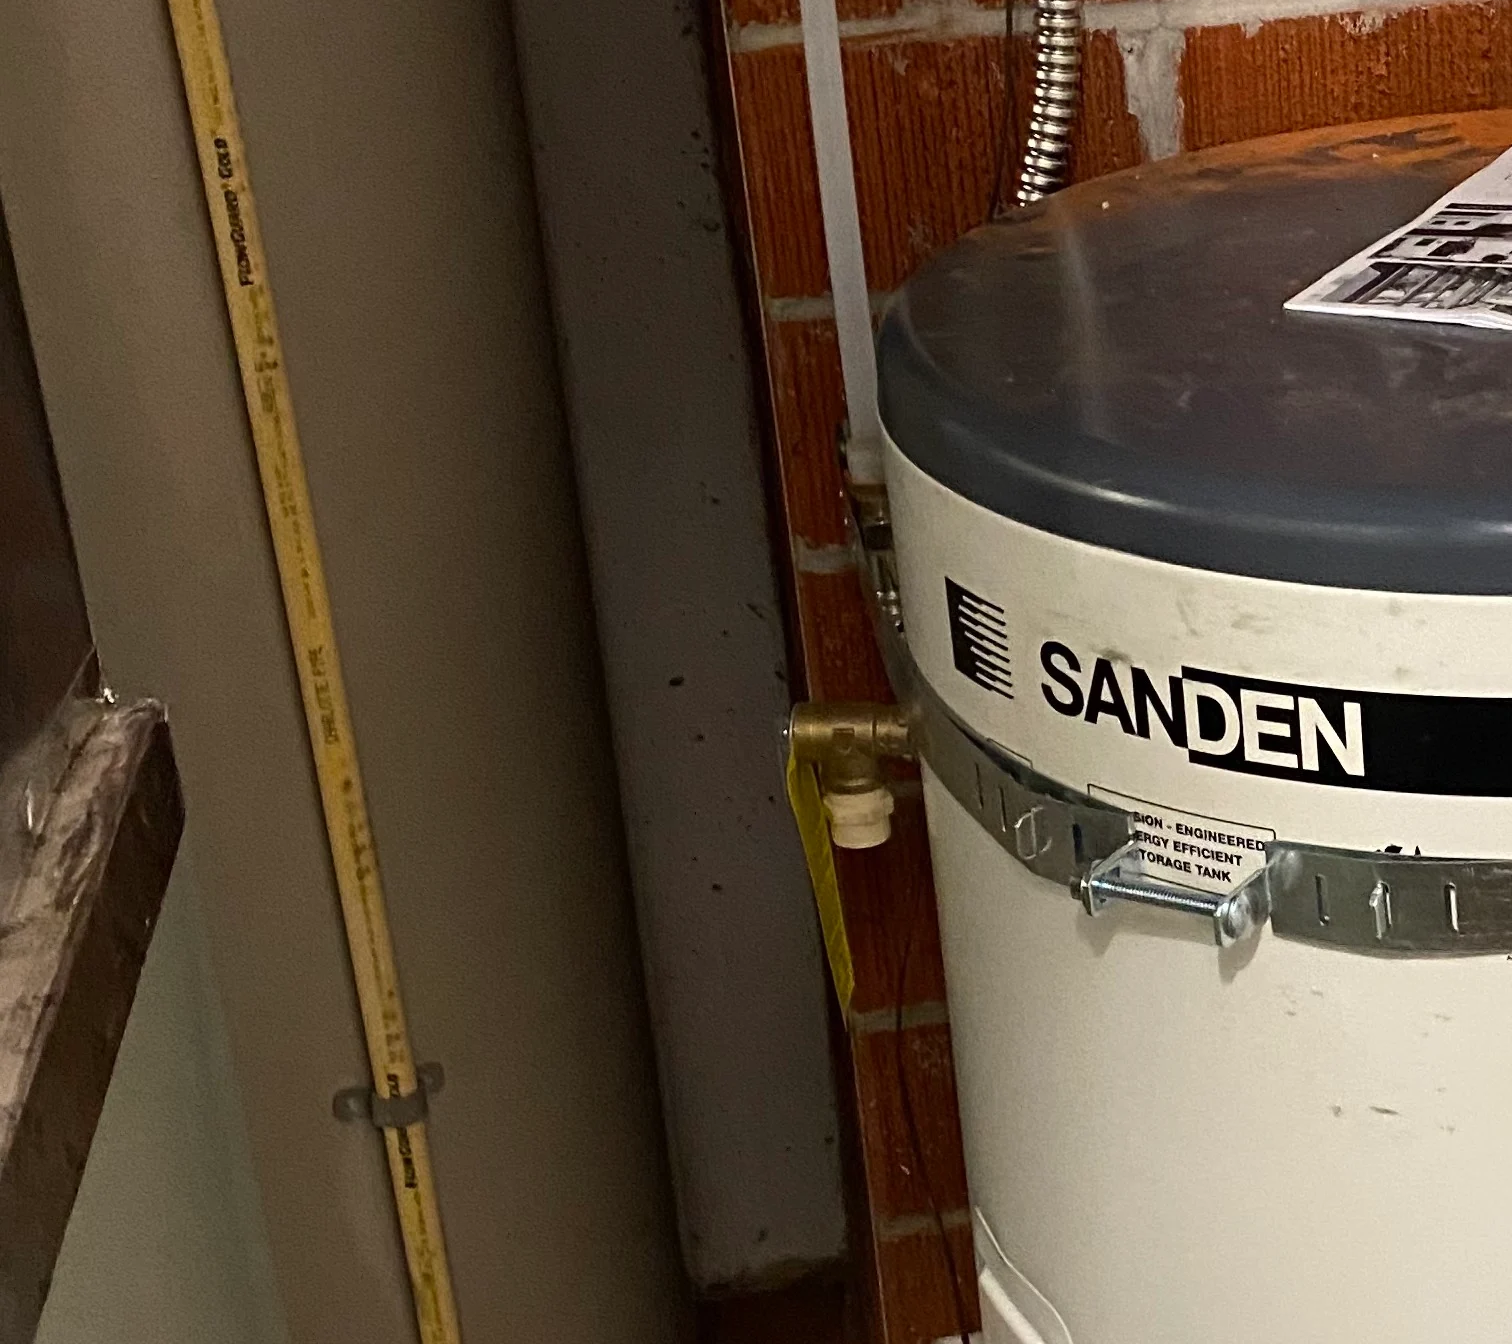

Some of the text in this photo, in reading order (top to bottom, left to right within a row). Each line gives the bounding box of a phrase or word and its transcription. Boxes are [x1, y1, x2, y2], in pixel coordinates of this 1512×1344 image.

[1040, 641, 1365, 777] SANDEN
[1133, 812, 1163, 829] SION
[1176, 823, 1265, 851] ENGINEERED
[1136, 830, 1242, 866] ERGY EFFICIENT
[1139, 848, 1231, 883] TORAGE TANK
